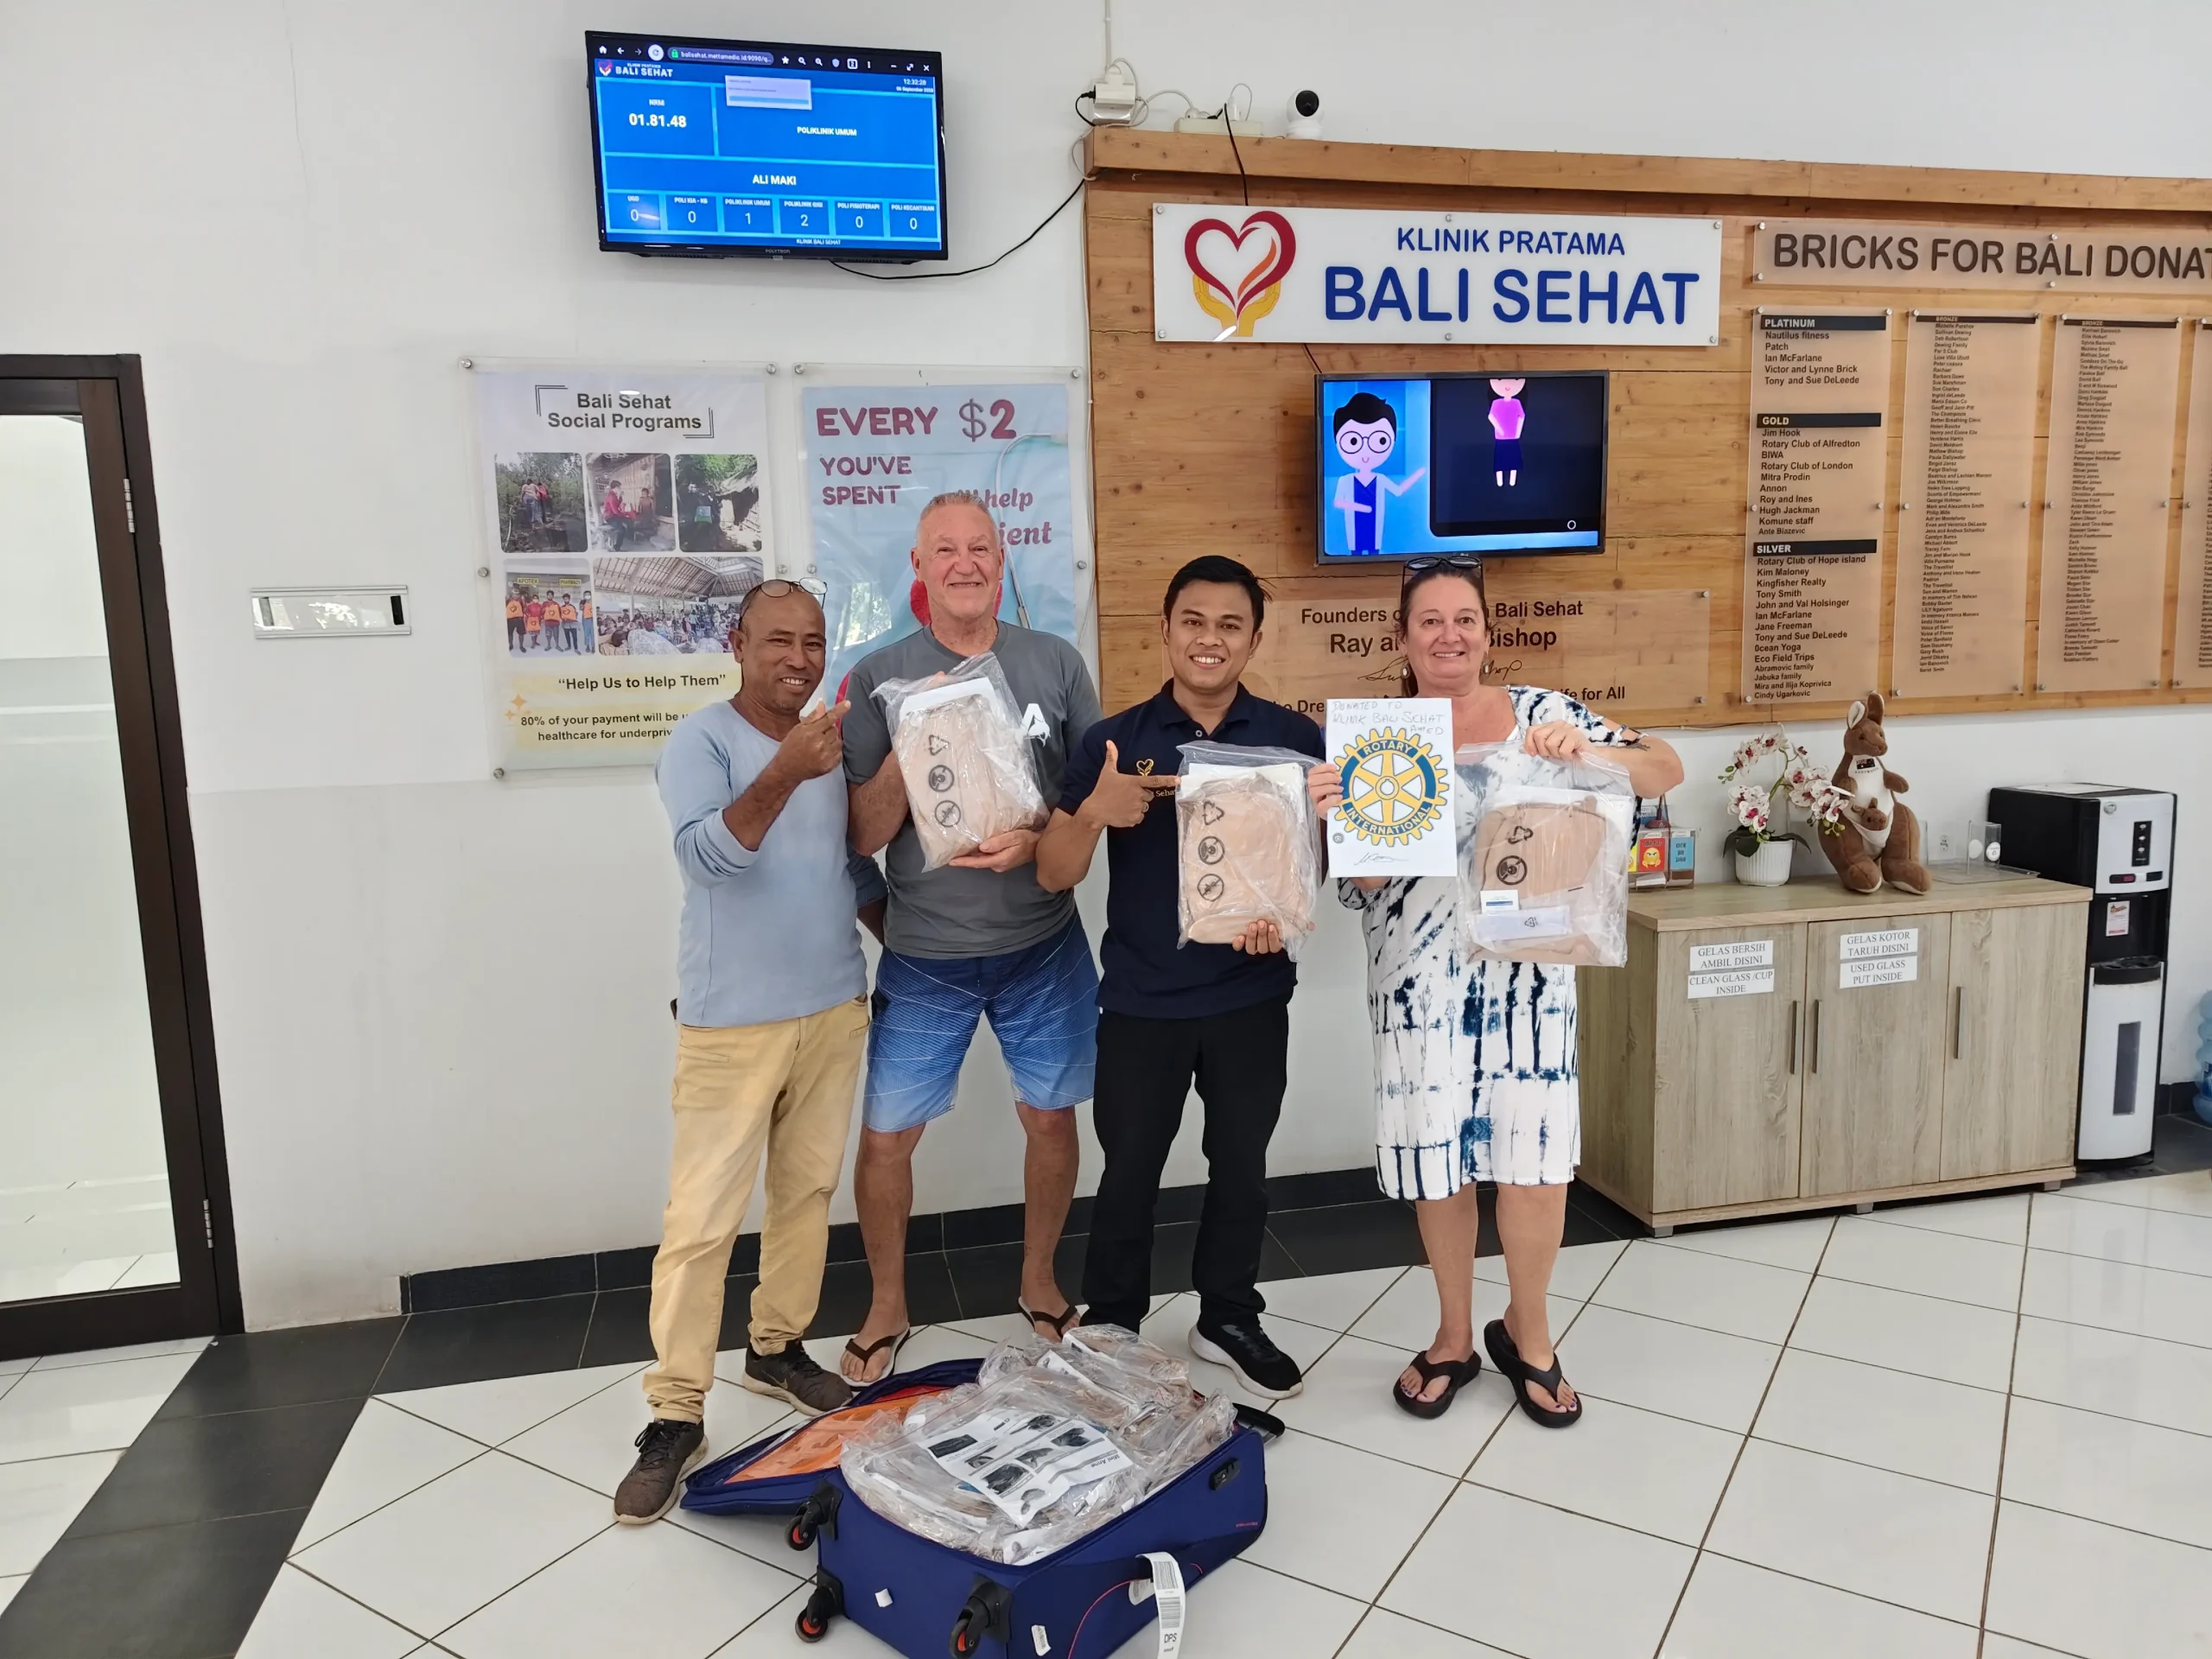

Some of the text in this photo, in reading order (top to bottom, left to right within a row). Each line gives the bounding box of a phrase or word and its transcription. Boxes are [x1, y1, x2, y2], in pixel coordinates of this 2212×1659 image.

[615, 67, 673, 77] BALI SEHAT
[629, 113, 686, 128] 01.81.48
[753, 175, 796, 186] ALI MAKI
[689, 211, 696, 223] 0
[745, 213, 751, 225] 1
[801, 214, 808, 226] 2
[855, 216, 863, 228] 0
[910, 218, 917, 230] 0
[1396, 227, 1626, 257] KLINIK PRATAMA
[1773, 233, 1918, 270] BRICKS
[1931, 238, 2003, 273] FOR
[2016, 241, 2093, 277] BALI
[1325, 265, 1700, 326] BALI SEHAT
[1765, 319, 1815, 327] PLATINUM
[1809, 365, 1834, 374] Lynne
[1765, 377, 1784, 386] Tony
[577, 393, 671, 409] Bali Sehat
[548, 413, 702, 432] Social Programs
[817, 398, 1017, 442] EVERY $2
[1762, 440, 1789, 448] Rotary
[819, 456, 912, 476] YOU'VE
[1761, 462, 1788, 471] Rotary
[823, 485, 901, 505] SPENT
[985, 488, 1033, 512] help
[1760, 495, 1776, 505] Roy
[1760, 507, 1781, 516] Hugh
[1758, 557, 1784, 566] Rotary
[1819, 556, 1839, 565] Hope
[1757, 578, 1826, 588] Kingfisher Realty
[1757, 591, 1776, 600] Tony
[1495, 601, 1583, 617] Bali Sehat
[1301, 607, 1387, 624] Founders
[1755, 634, 1774, 643] Tony
[1330, 633, 1373, 657] Ray
[1781, 644, 1801, 652] Yoga
[1795, 653, 1815, 662] Trips
[603, 677, 621, 688] Us
[626, 677, 639, 688] to
[645, 676, 676, 689] Help
[1582, 687, 1624, 700] for All
[1332, 702, 1377, 713] DONATED
[521, 712, 678, 726] 80% of your payment will be
[1402, 712, 1446, 723] SEHAT
[538, 729, 615, 741] healthcare for
[1363, 741, 1414, 755] ROTARY
[1346, 806, 1431, 835] INTERNATIONAL
[1847, 931, 1910, 944] GELAS KOTOR
[1698, 944, 1765, 957] GELAS BERSIH
[1847, 944, 1909, 956] TARUH DISINI
[1700, 956, 1763, 969] AMBIL DISINI
[1851, 960, 1905, 973] USED GLASS
[1689, 976, 1719, 985] CLEAN
[1722, 973, 1751, 982] GLASS
[1853, 972, 1903, 984] PUT INSIDE
[1716, 985, 1745, 995] INSIDE
[1164, 1633, 1177, 1643] DPS
